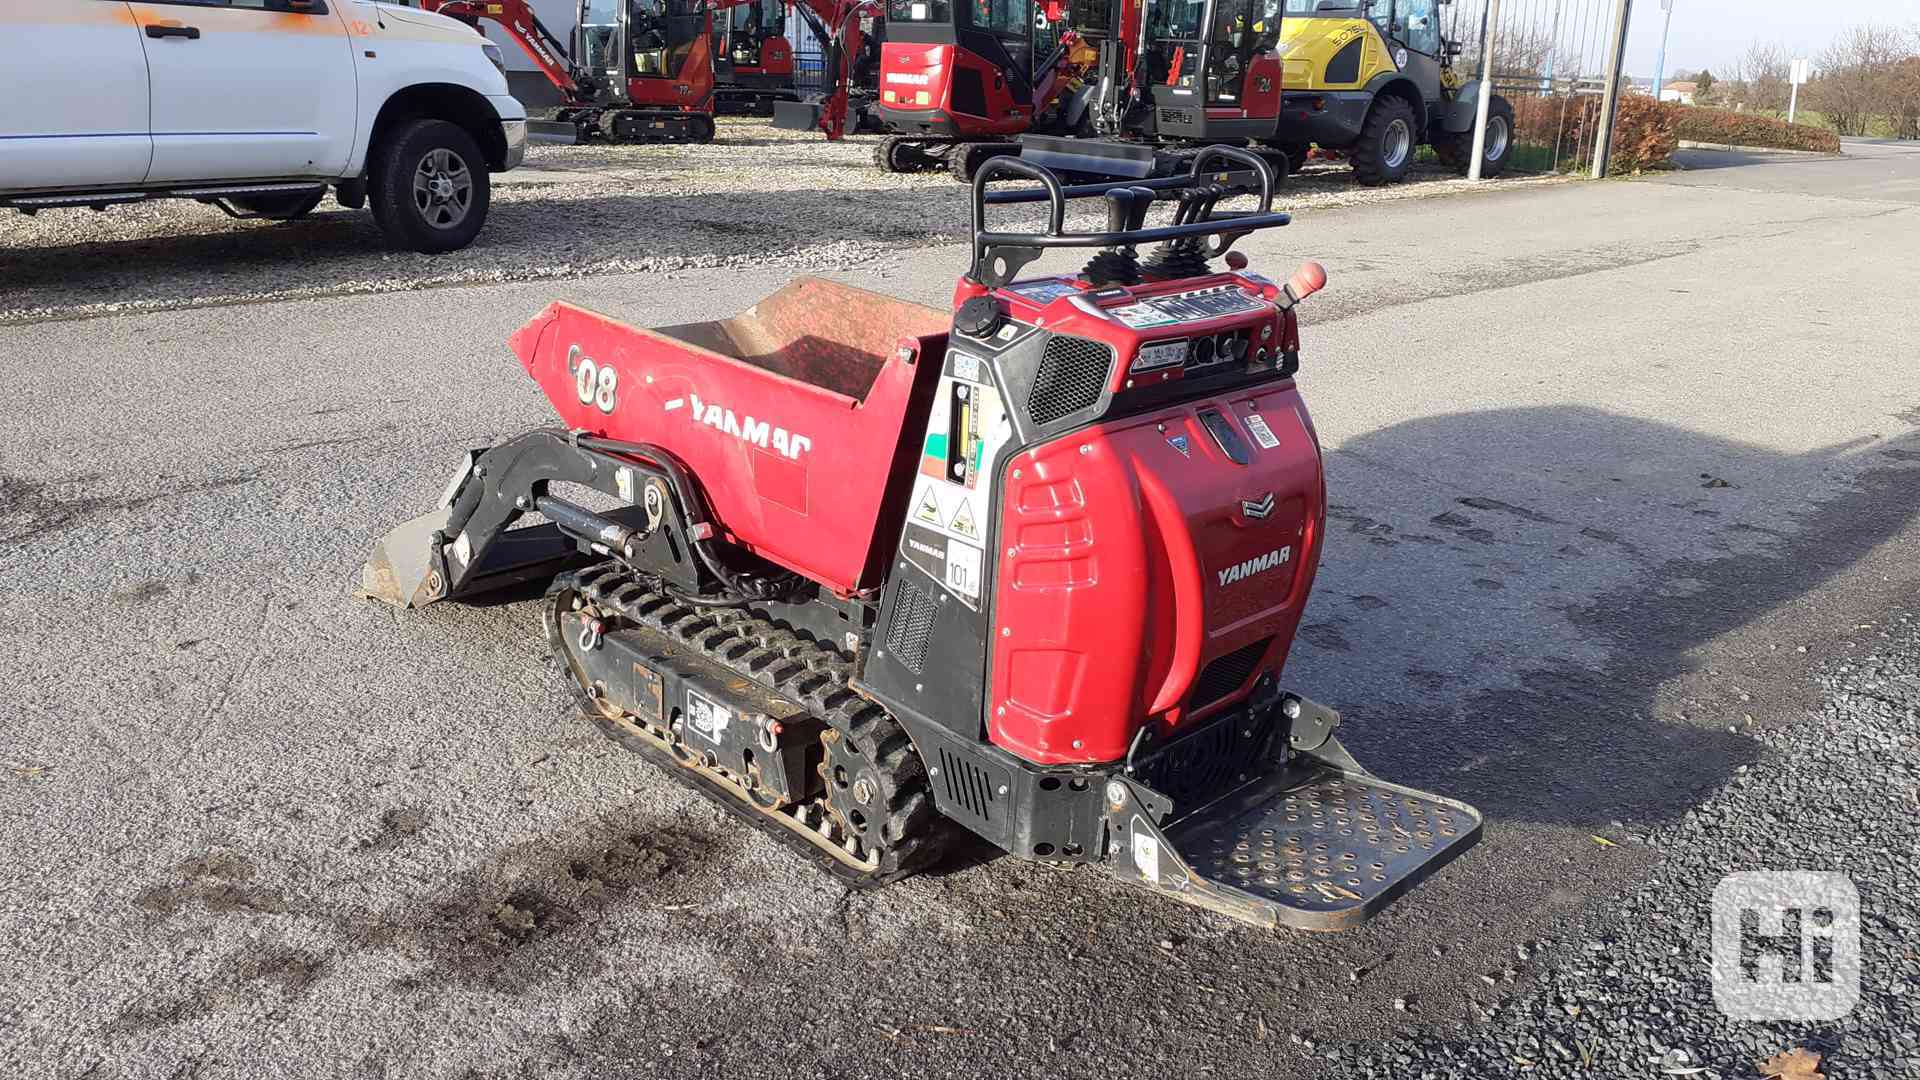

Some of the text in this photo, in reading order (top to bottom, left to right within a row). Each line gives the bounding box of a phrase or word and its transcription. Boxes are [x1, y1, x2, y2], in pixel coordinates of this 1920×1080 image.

[909, 538, 944, 560] YANMAR
[950, 562, 967, 589] 101
[1218, 545, 1290, 586] YANMAR
